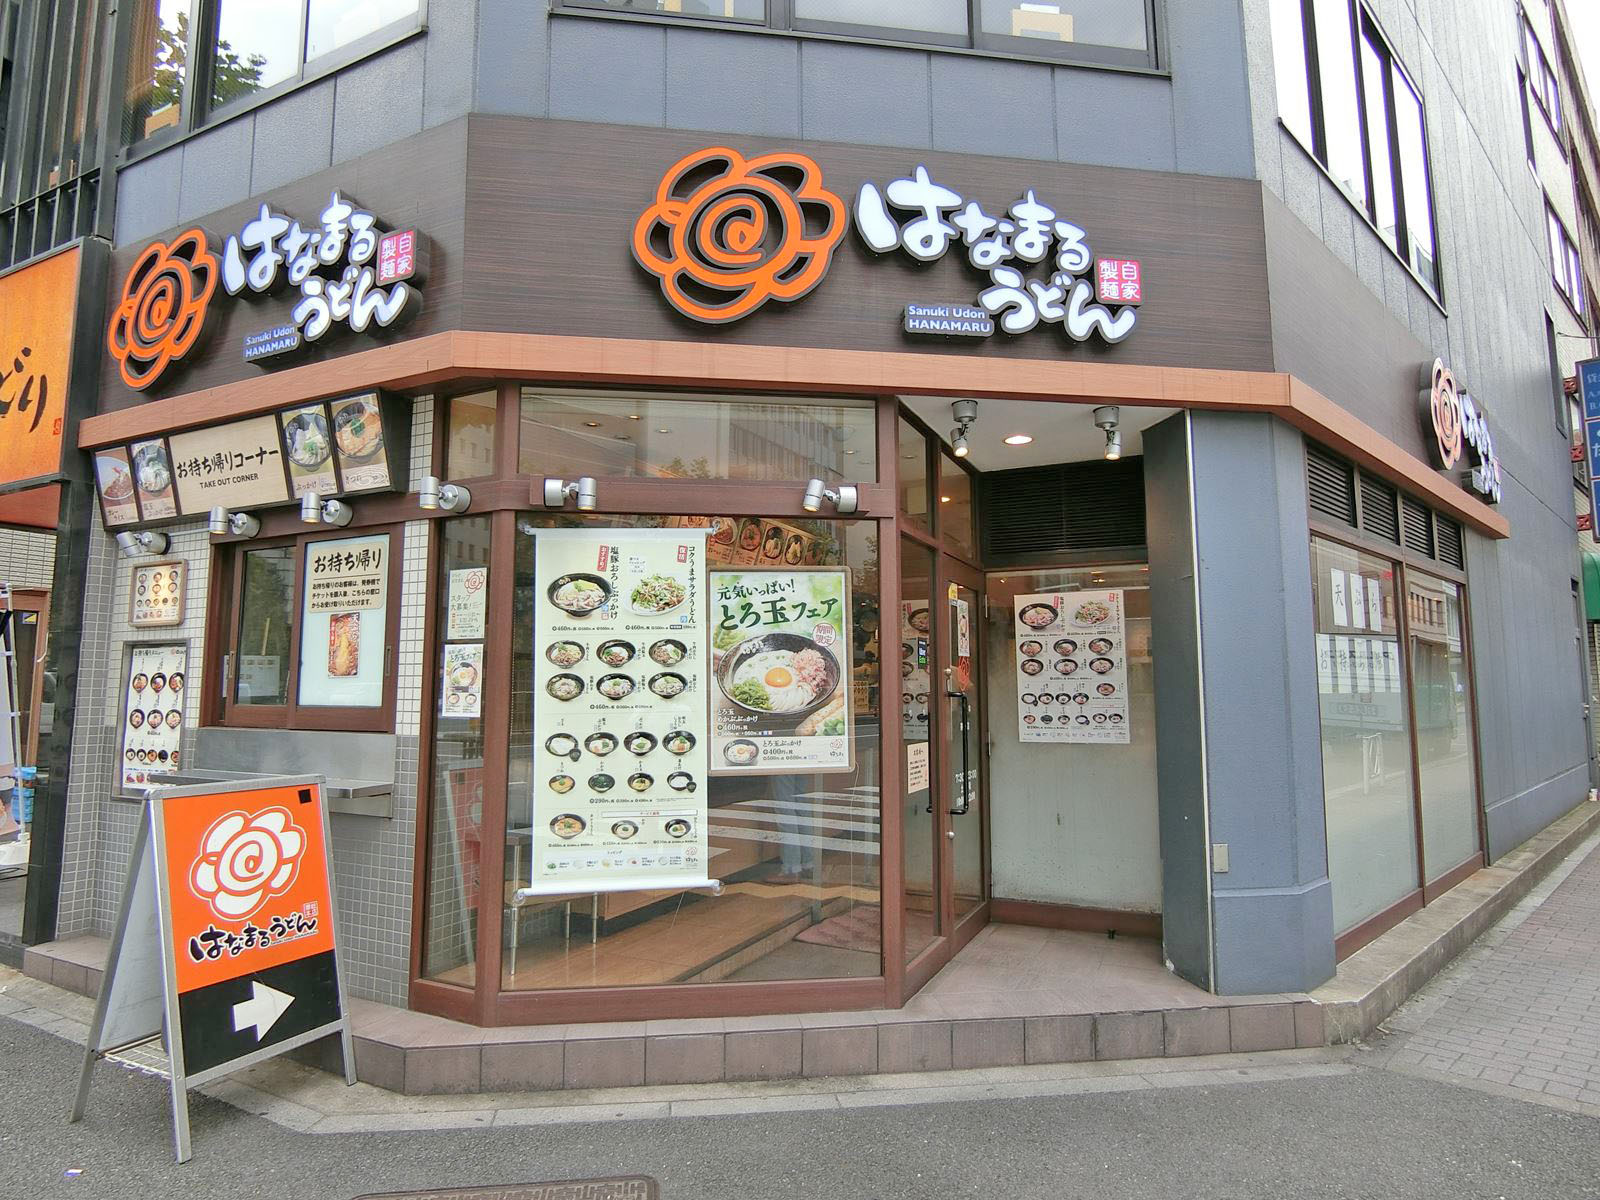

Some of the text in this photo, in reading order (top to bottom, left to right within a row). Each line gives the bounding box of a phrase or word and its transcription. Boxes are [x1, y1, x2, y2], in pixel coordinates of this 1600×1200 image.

[857, 166, 1090, 272] はなまる
[223, 192, 376, 292] はなまる
[294, 267, 406, 340] うどん
[908, 305, 986, 319] Sanuki Udon
[981, 267, 1136, 339] うどん
[245, 326, 296, 346] Sanuki Udon
[908, 318, 990, 333] HANAMARU
[245, 336, 298, 358] HANAMARU
[176, 446, 279, 479] お持ち帰りコーナー
[199, 473, 259, 489] TAKE OUT CORNER
[313, 548, 382, 574] お持ち帰り
[719, 596, 839, 631] とろ玉フェア
[190, 913, 317, 962] はなまるうどん
